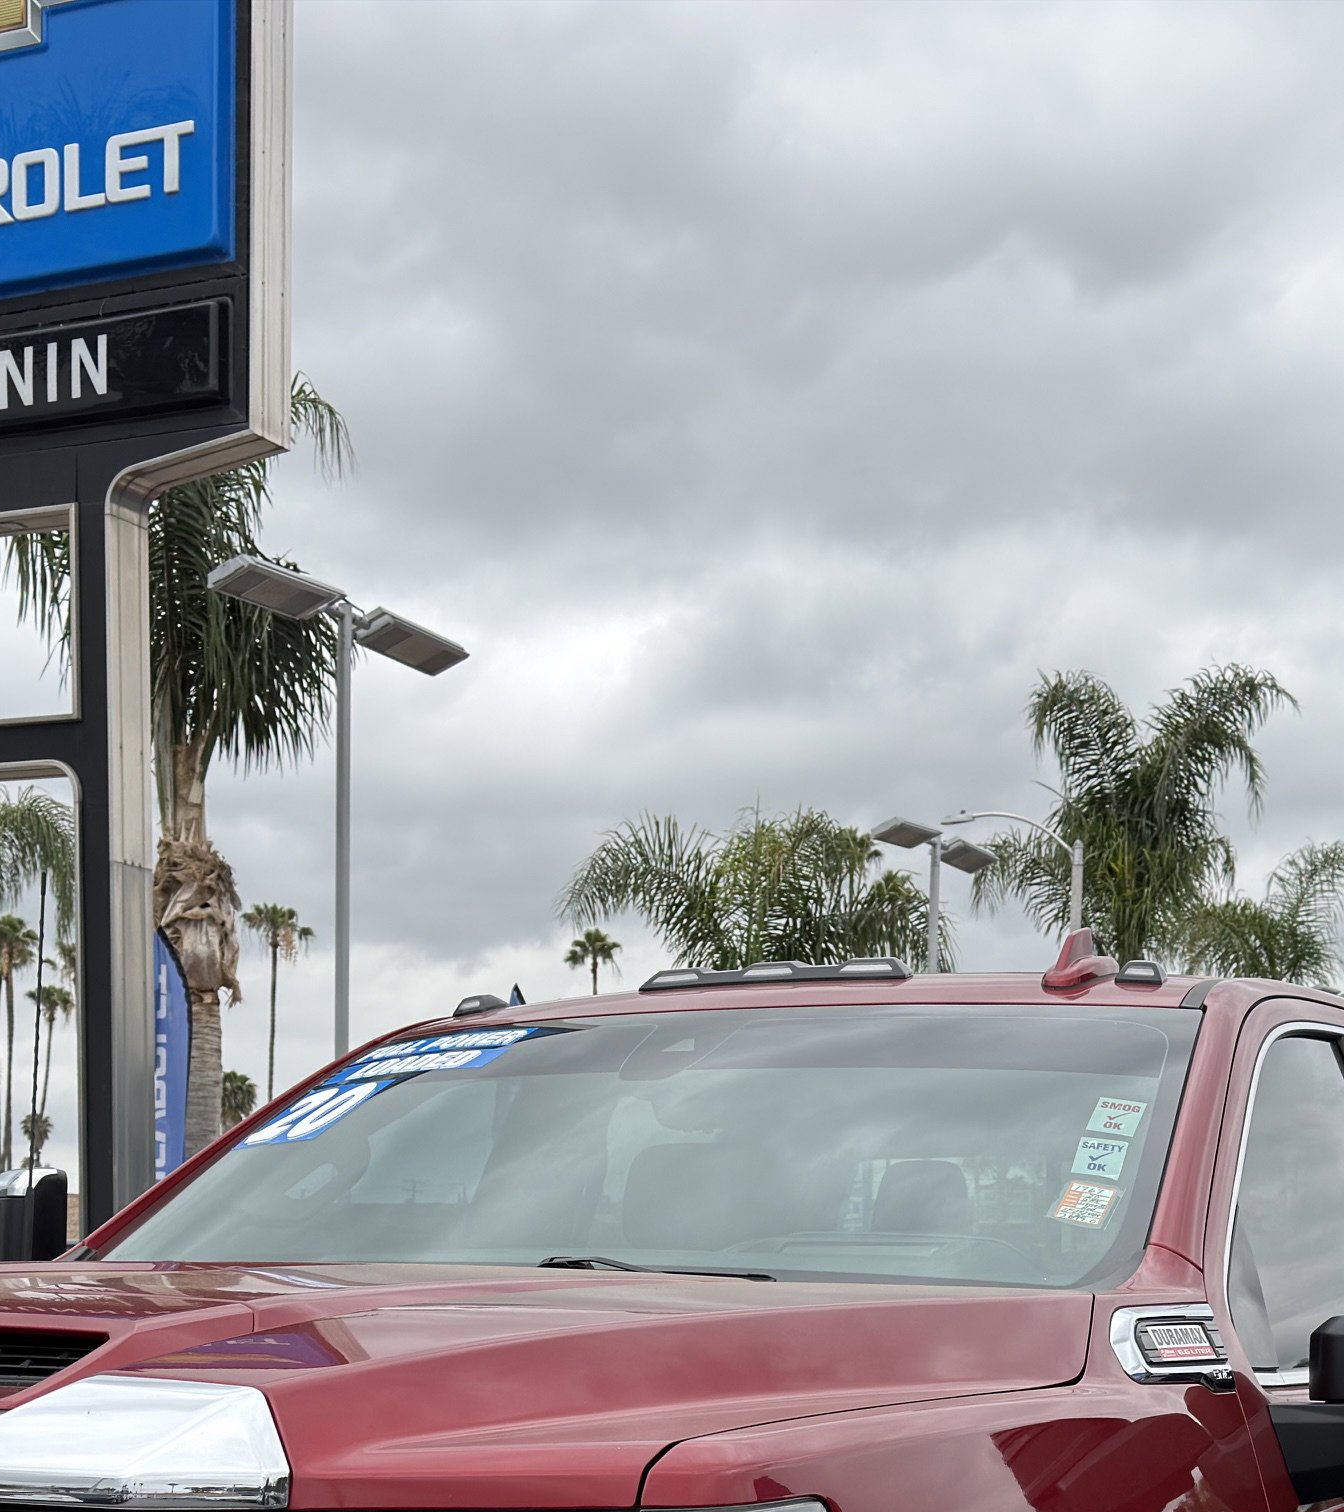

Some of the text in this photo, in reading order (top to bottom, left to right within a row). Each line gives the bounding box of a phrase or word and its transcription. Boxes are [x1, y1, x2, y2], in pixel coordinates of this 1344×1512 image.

[419, 1028, 529, 1052] POWER
[345, 1049, 482, 1081] LOADED
[243, 1081, 378, 1146] 20
[1100, 1101, 1141, 1113] SMOG
[1103, 1121, 1123, 1130] OK
[1081, 1141, 1125, 1153] SAFETY
[1087, 1162, 1107, 1172] OK
[1151, 1328, 1207, 1345] DURAMAX
